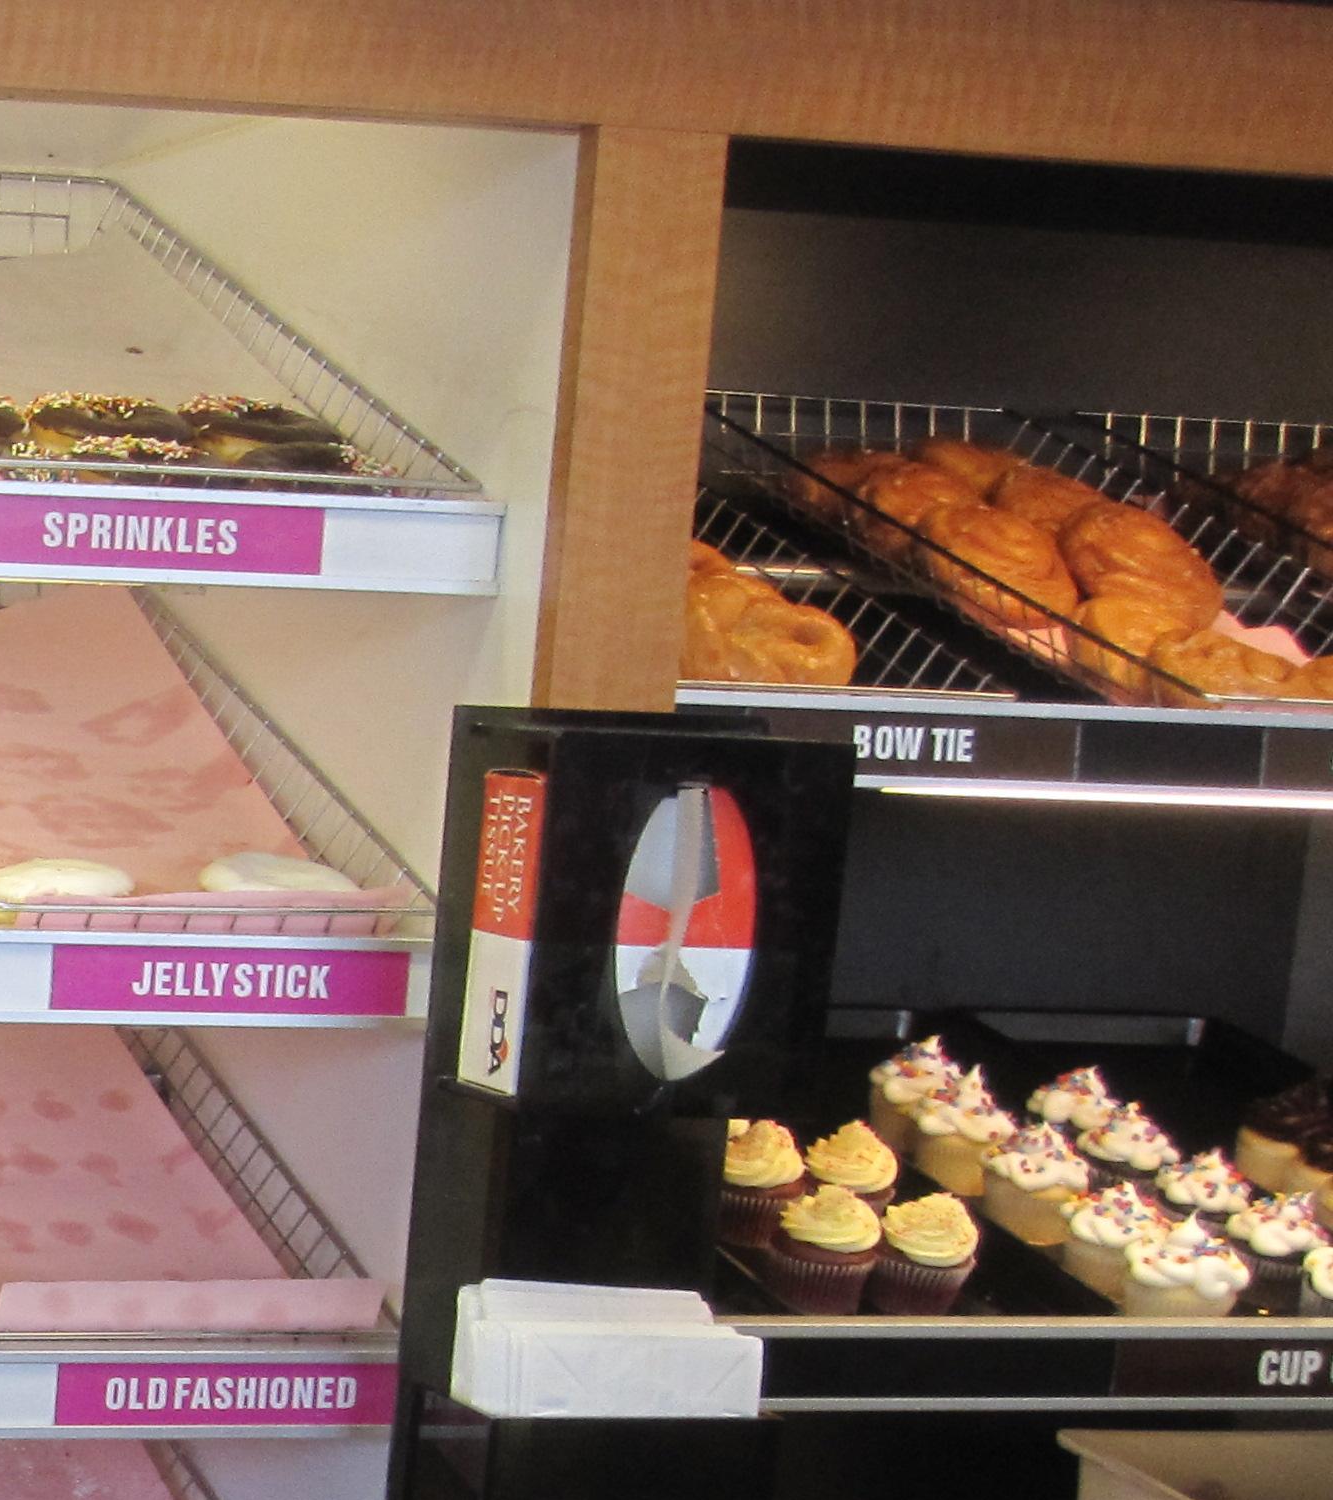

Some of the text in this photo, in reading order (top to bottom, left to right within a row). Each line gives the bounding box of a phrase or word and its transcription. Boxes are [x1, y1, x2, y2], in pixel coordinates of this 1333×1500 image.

[42, 510, 238, 555] SPRINKLES
[853, 724, 975, 763] BOW TIE
[131, 961, 330, 999] JELLY STICK
[1257, 1349, 1324, 1386] CUP
[105, 1376, 357, 1411] OLD FASHIONED
